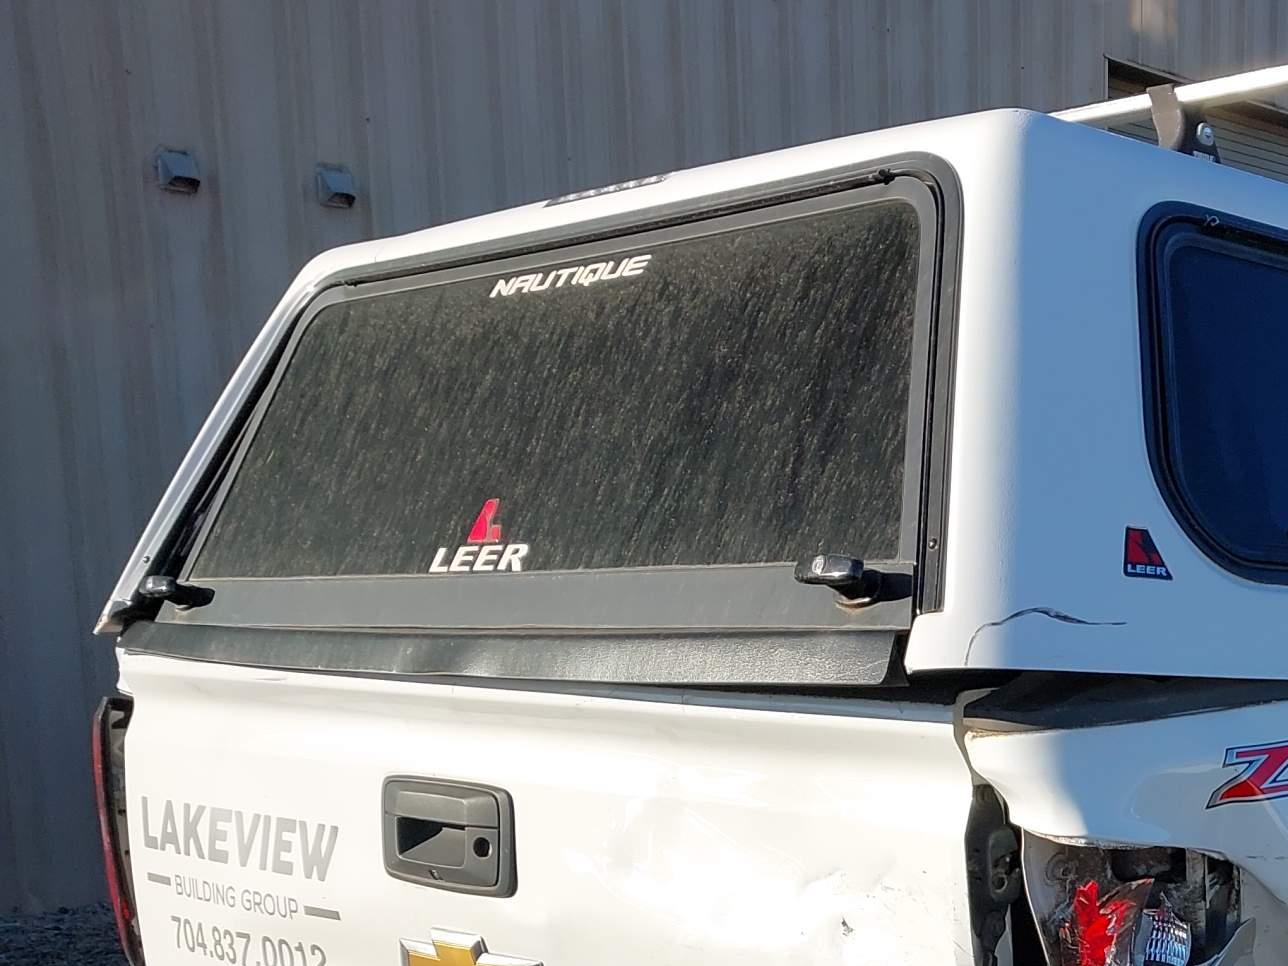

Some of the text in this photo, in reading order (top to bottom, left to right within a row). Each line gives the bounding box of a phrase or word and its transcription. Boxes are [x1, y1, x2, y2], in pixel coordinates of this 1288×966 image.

[489, 254, 652, 299] NAUTIQUE
[428, 543, 529, 574] LEER
[1126, 563, 1168, 577] LEER
[140, 795, 339, 883] LAKEVIEW
[173, 873, 299, 920] BUILDING GROUP
